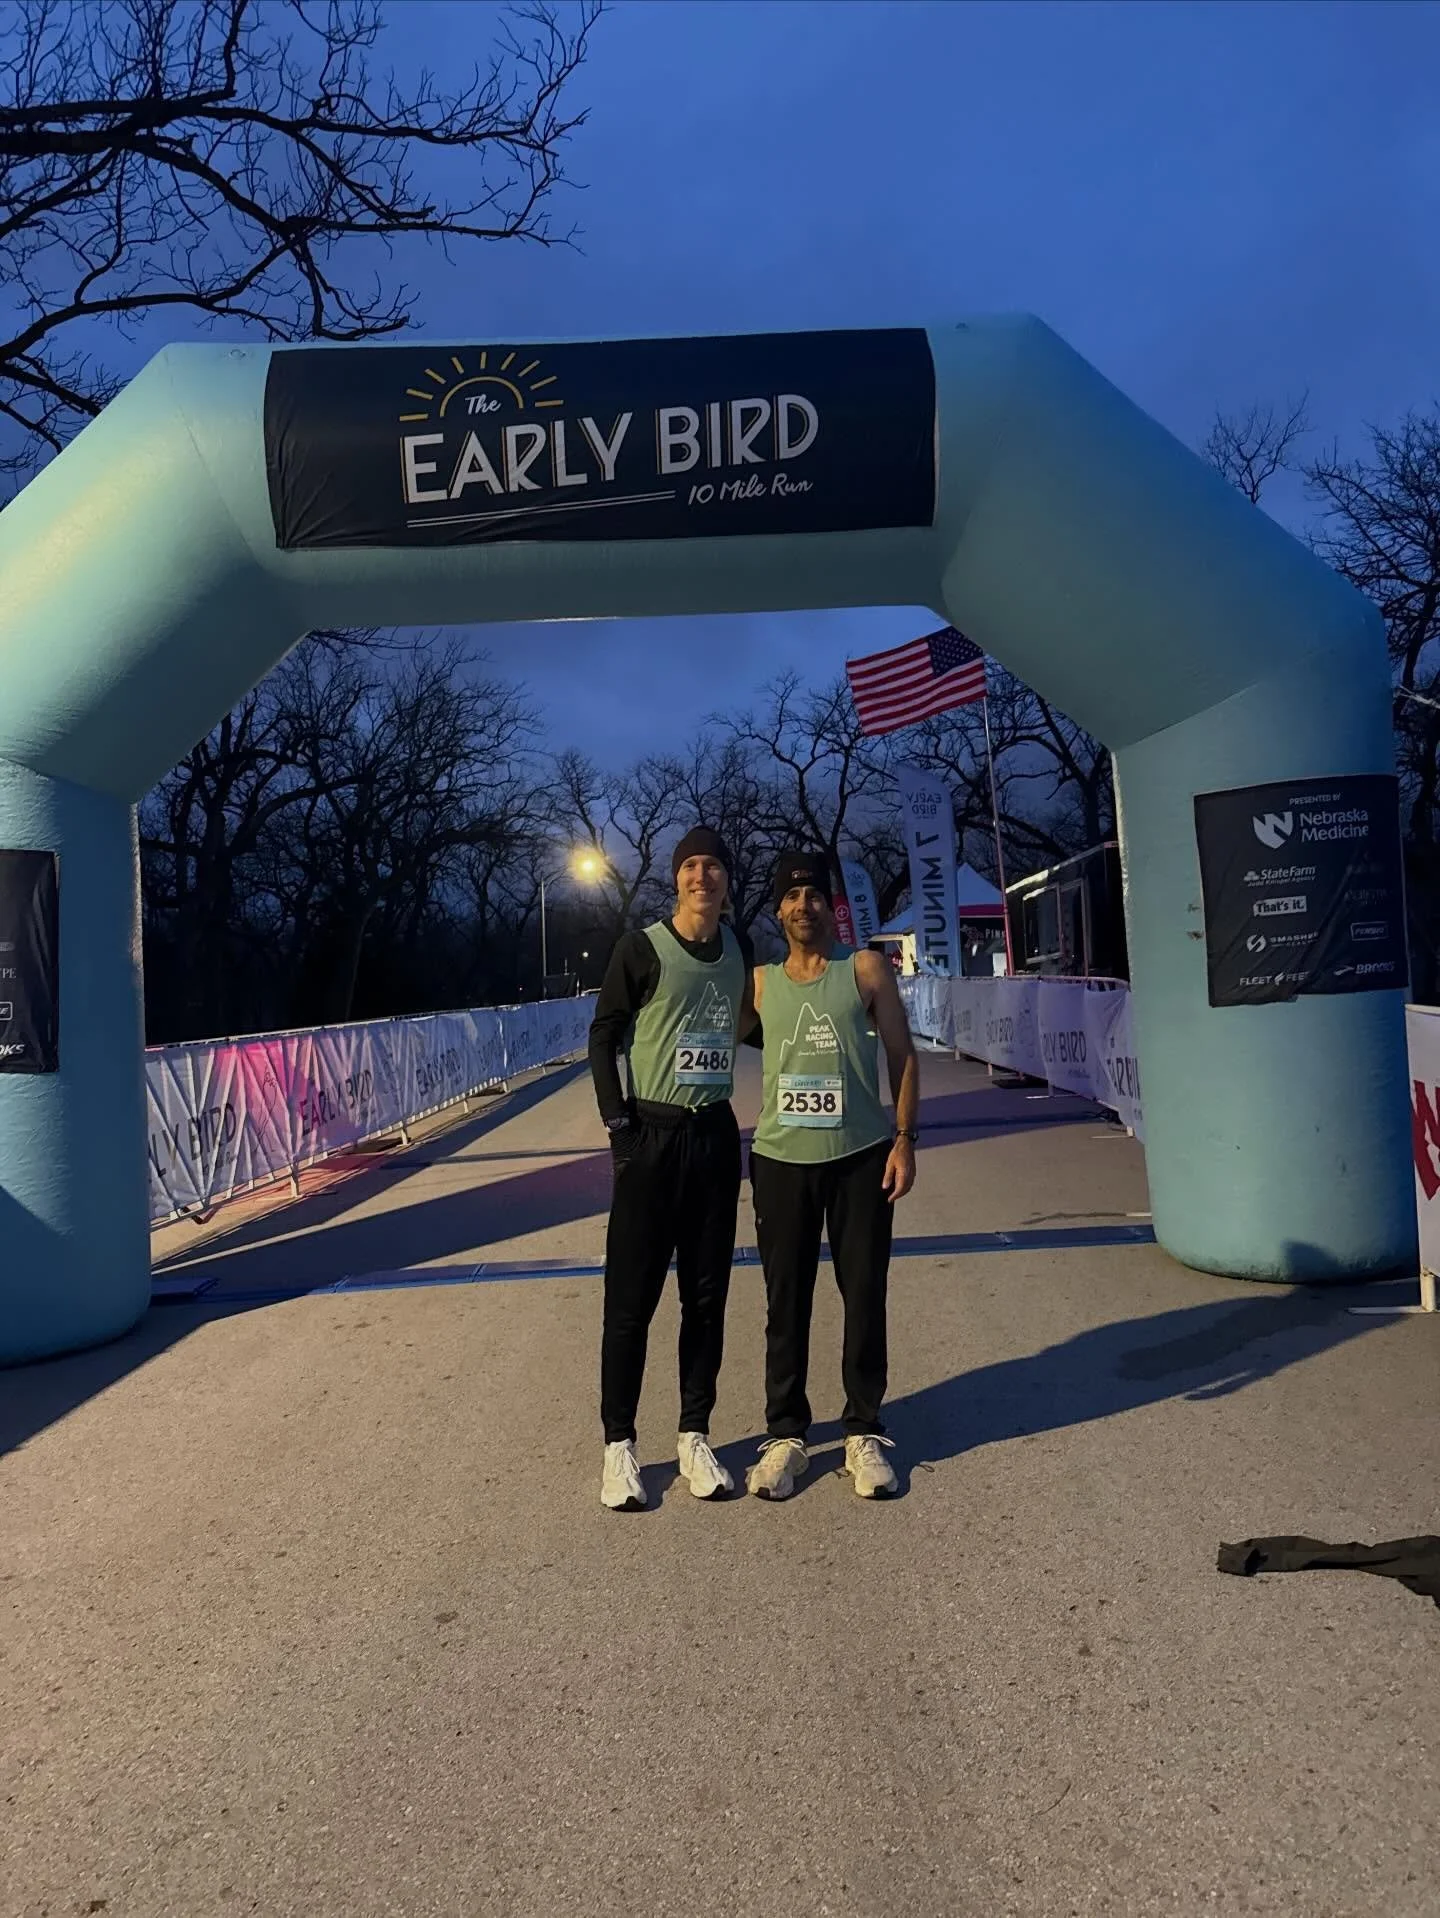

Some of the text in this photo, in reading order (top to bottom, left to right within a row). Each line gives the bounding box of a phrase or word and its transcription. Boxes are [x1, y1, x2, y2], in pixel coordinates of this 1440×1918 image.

[465, 394, 501, 416] The
[401, 393, 820, 503] EARLY BIRD
[687, 476, 812, 506] 10 Mile Run
[1289, 793, 1341, 805] PRESENTED BY
[1300, 808, 1369, 827] Nebraska
[1301, 824, 1369, 842] Medicine
[1256, 901, 1289, 913] That's
[805, 1032, 834, 1042] RACING
[809, 1024, 831, 1034] PEAK
[814, 1040, 837, 1049] TEAM
[1059, 1030, 1087, 1064] BIRD
[679, 1050, 729, 1071] 2486
[782, 1091, 837, 1113] 2538
